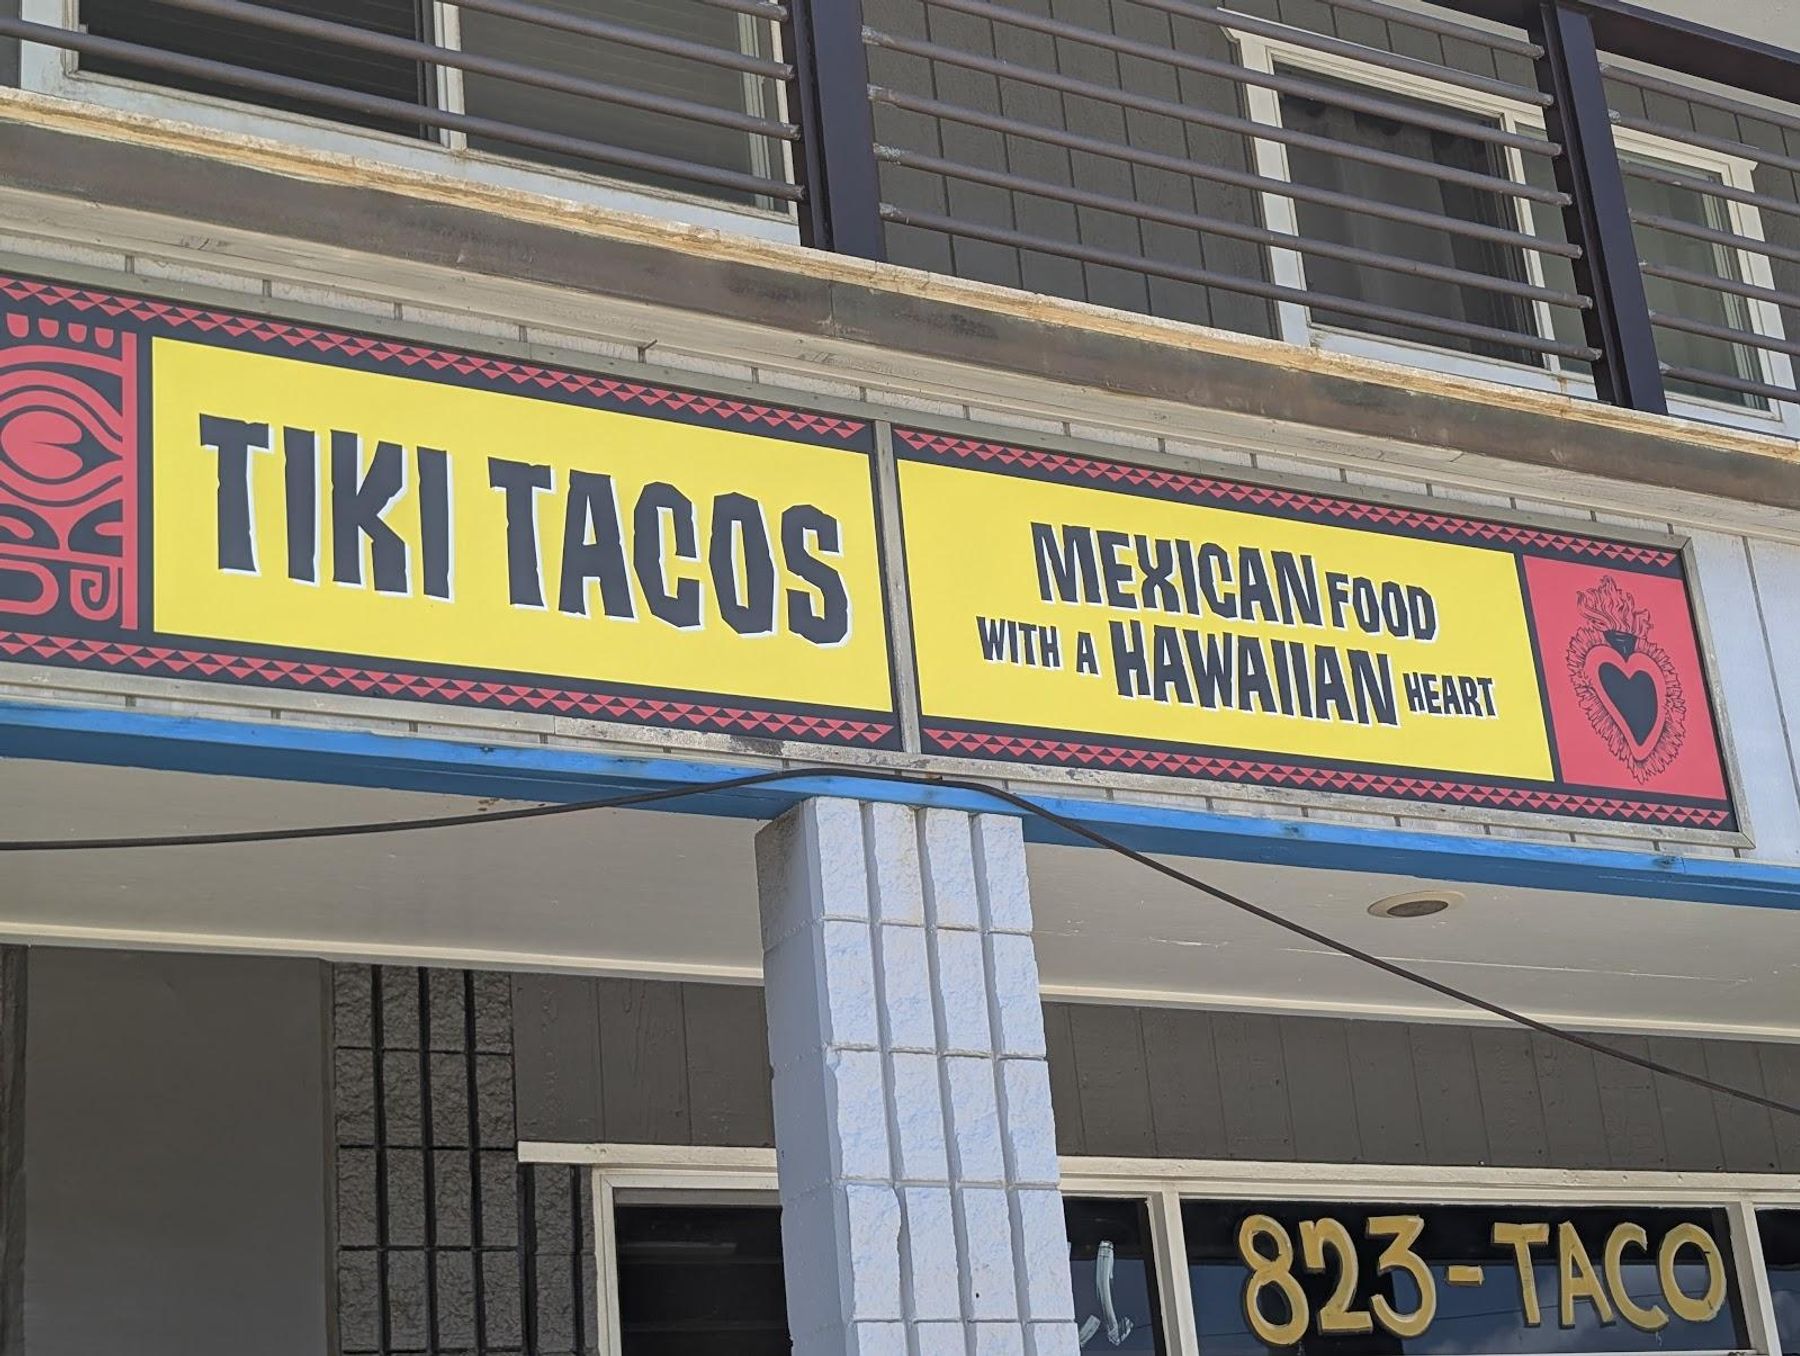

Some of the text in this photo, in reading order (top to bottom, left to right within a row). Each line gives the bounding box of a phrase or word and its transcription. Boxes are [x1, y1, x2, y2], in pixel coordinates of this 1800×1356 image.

[200, 413, 852, 648] TIKI TACOS
[1031, 522, 1439, 643] MEXICAN FOOD
[976, 616, 1499, 727] WITH A HAWAIIAN HEART
